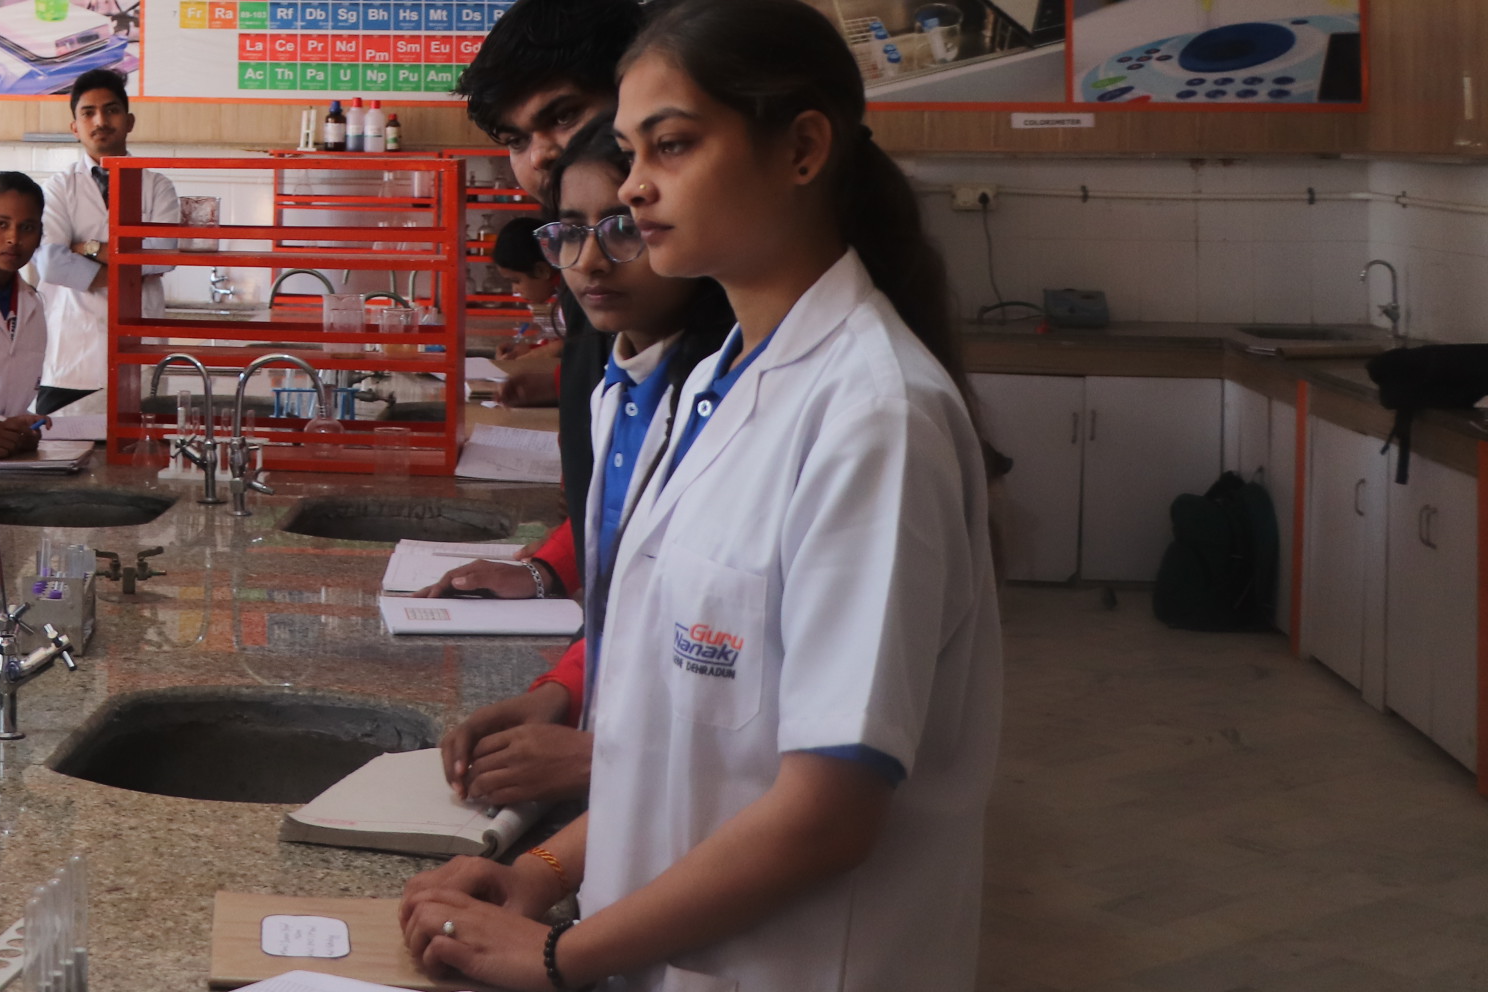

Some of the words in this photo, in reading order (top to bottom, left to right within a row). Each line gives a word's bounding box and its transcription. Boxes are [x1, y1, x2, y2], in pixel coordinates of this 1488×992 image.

[188, 8, 202, 18] Fr
[215, 8, 233, 19] Ra
[277, 8, 293, 19] Rf
[306, 9, 326, 20] Db
[338, 9, 357, 22] Sg
[368, 9, 388, 20] Bh
[400, 9, 418, 21] Hs
[430, 10, 447, 21] Mt
[463, 10, 481, 21] Ds
[247, 40, 263, 51] La
[275, 40, 294, 51] Ce
[308, 40, 324, 51] Pr
[336, 40, 356, 51] Nd
[366, 50, 389, 61] Pm
[397, 42, 420, 52] Sm
[431, 42, 450, 53] Eu
[461, 42, 481, 53] Gd
[245, 68, 264, 79] Ac
[276, 68, 293, 79] Th
[307, 69, 324, 80] Pa
[340, 70, 351, 80] U
[367, 71, 387, 83] Np
[399, 71, 418, 82] Pu
[427, 71, 452, 82] Am
[690, 624, 744, 651] Guru
